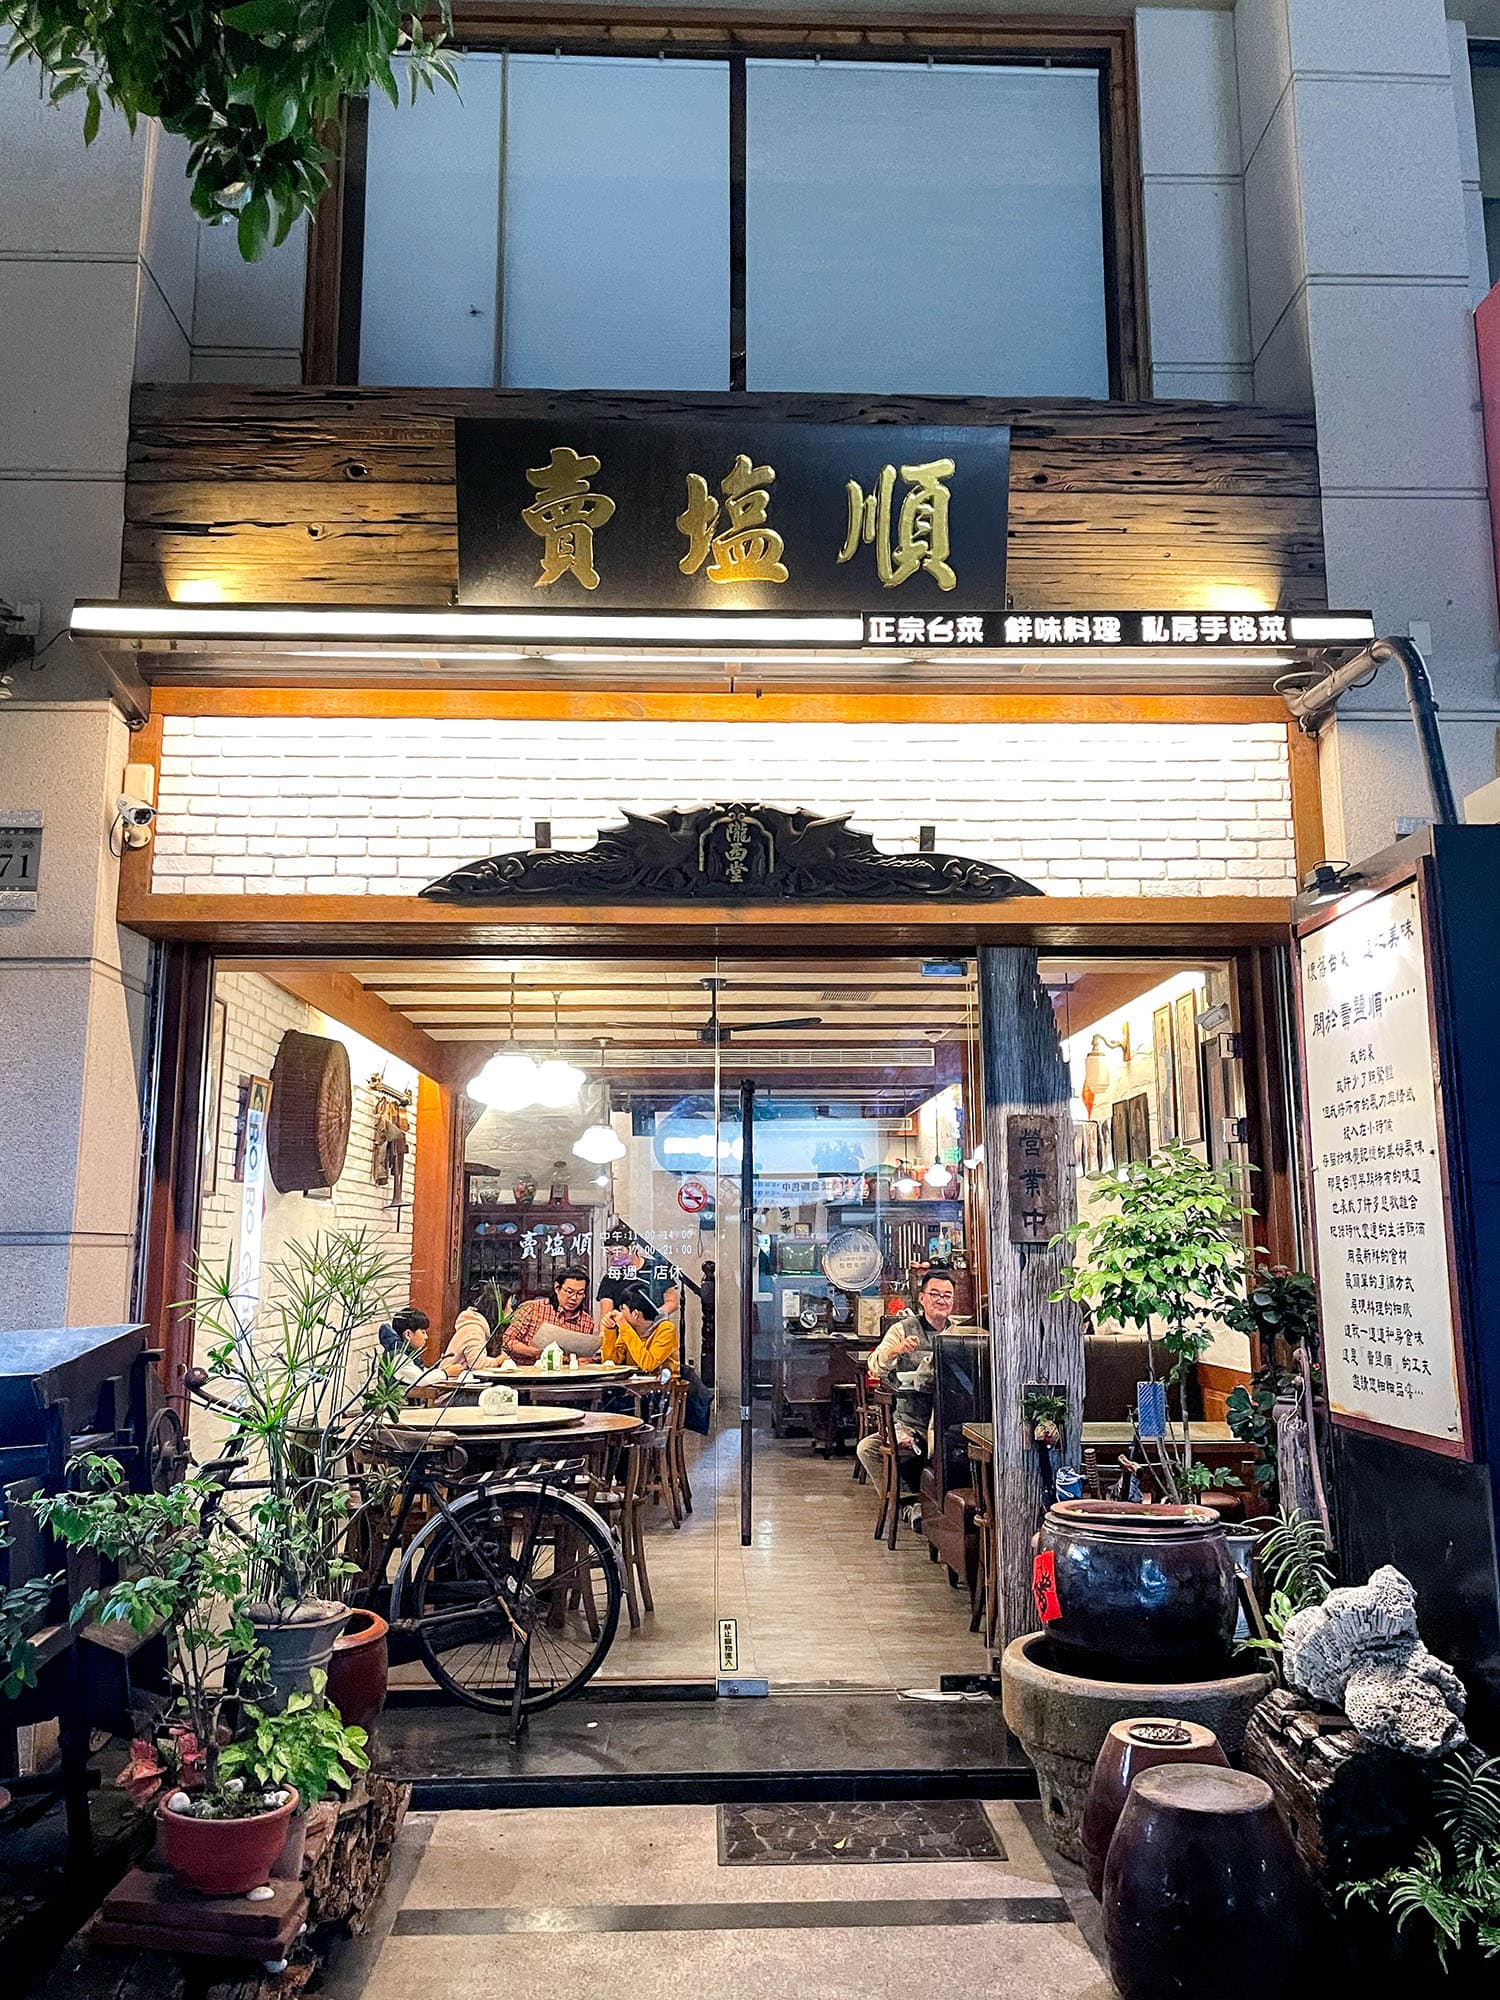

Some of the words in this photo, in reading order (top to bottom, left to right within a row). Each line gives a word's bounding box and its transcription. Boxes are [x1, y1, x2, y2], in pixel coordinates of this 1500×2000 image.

[868, 616, 984, 643] 正宗台菜
[1004, 616, 1121, 643] 鮮味料理
[1141, 616, 1287, 643] 私房手路菜
[1019, 1129, 1047, 1236] 營業中
[607, 1265, 683, 1281] 每週一店休
